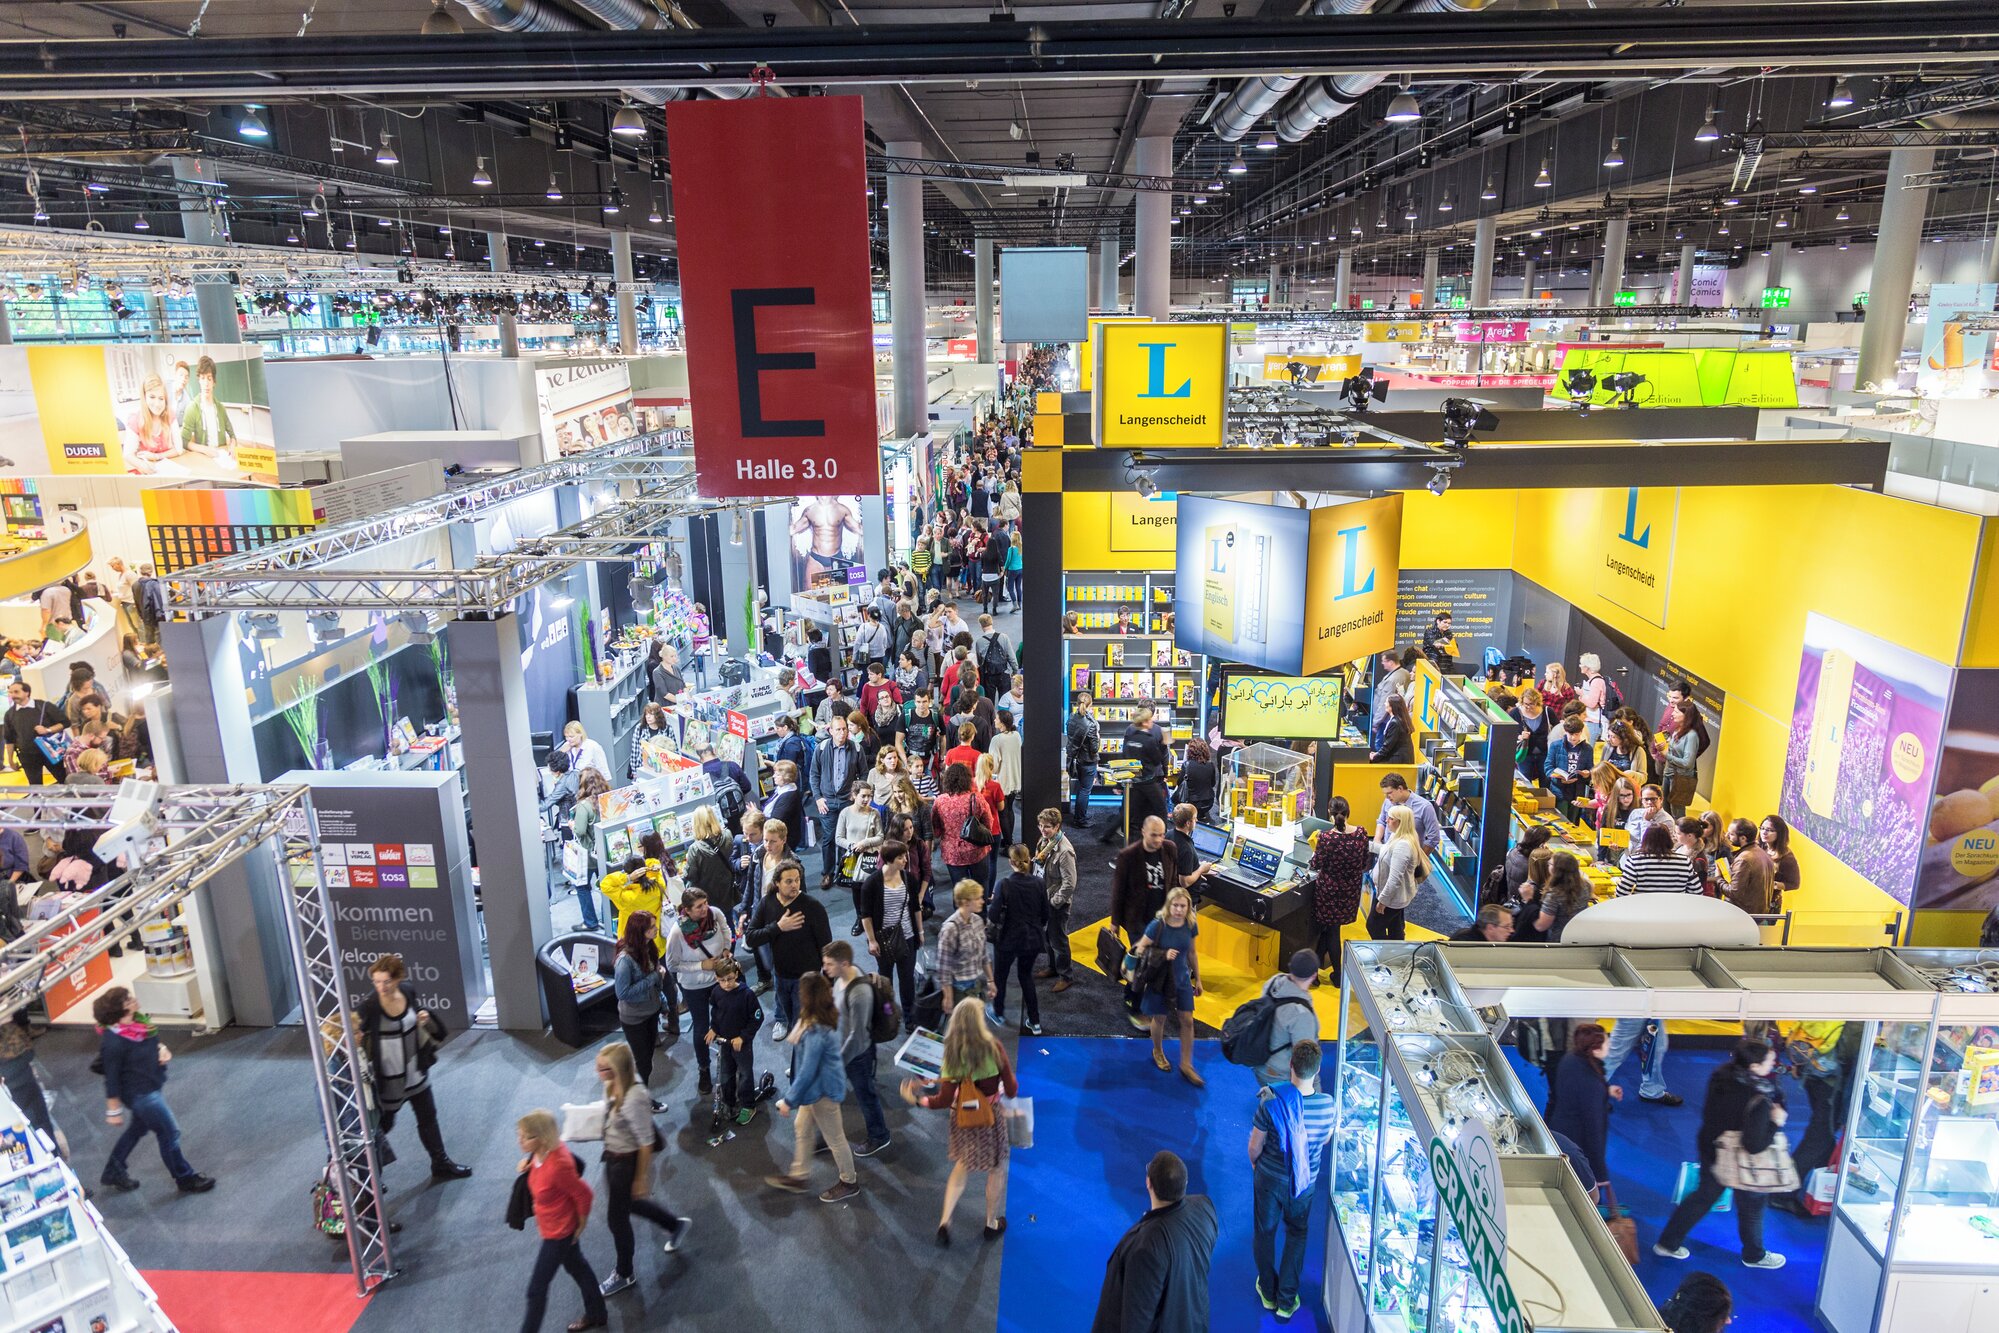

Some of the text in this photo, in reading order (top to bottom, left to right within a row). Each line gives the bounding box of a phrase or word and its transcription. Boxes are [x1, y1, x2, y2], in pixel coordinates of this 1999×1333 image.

[1691, 278, 1718, 287] Comic
[1690, 288, 1721, 296] Comics
[731, 287, 825, 438] E
[1319, 362, 1348, 375] Arena
[1137, 343, 1191, 398] L
[1119, 414, 1207, 428] Langenscheidt
[65, 446, 101, 456] DUDEN
[736, 458, 837, 480] Halle 3.0
[1334, 525, 1375, 601] L
[849, 571, 865, 580] tosa
[1606, 553, 1655, 588] Langenscheidt
[1318, 609, 1384, 641] Langenscheidt
[751, 689, 772, 699] VERLAG
[1899, 740, 1919, 758] NEU
[1963, 838, 1996, 850] NEU
[381, 872, 406, 882] tosa
[351, 924, 447, 942] Bienvenue
[340, 948, 403, 963] elcome
